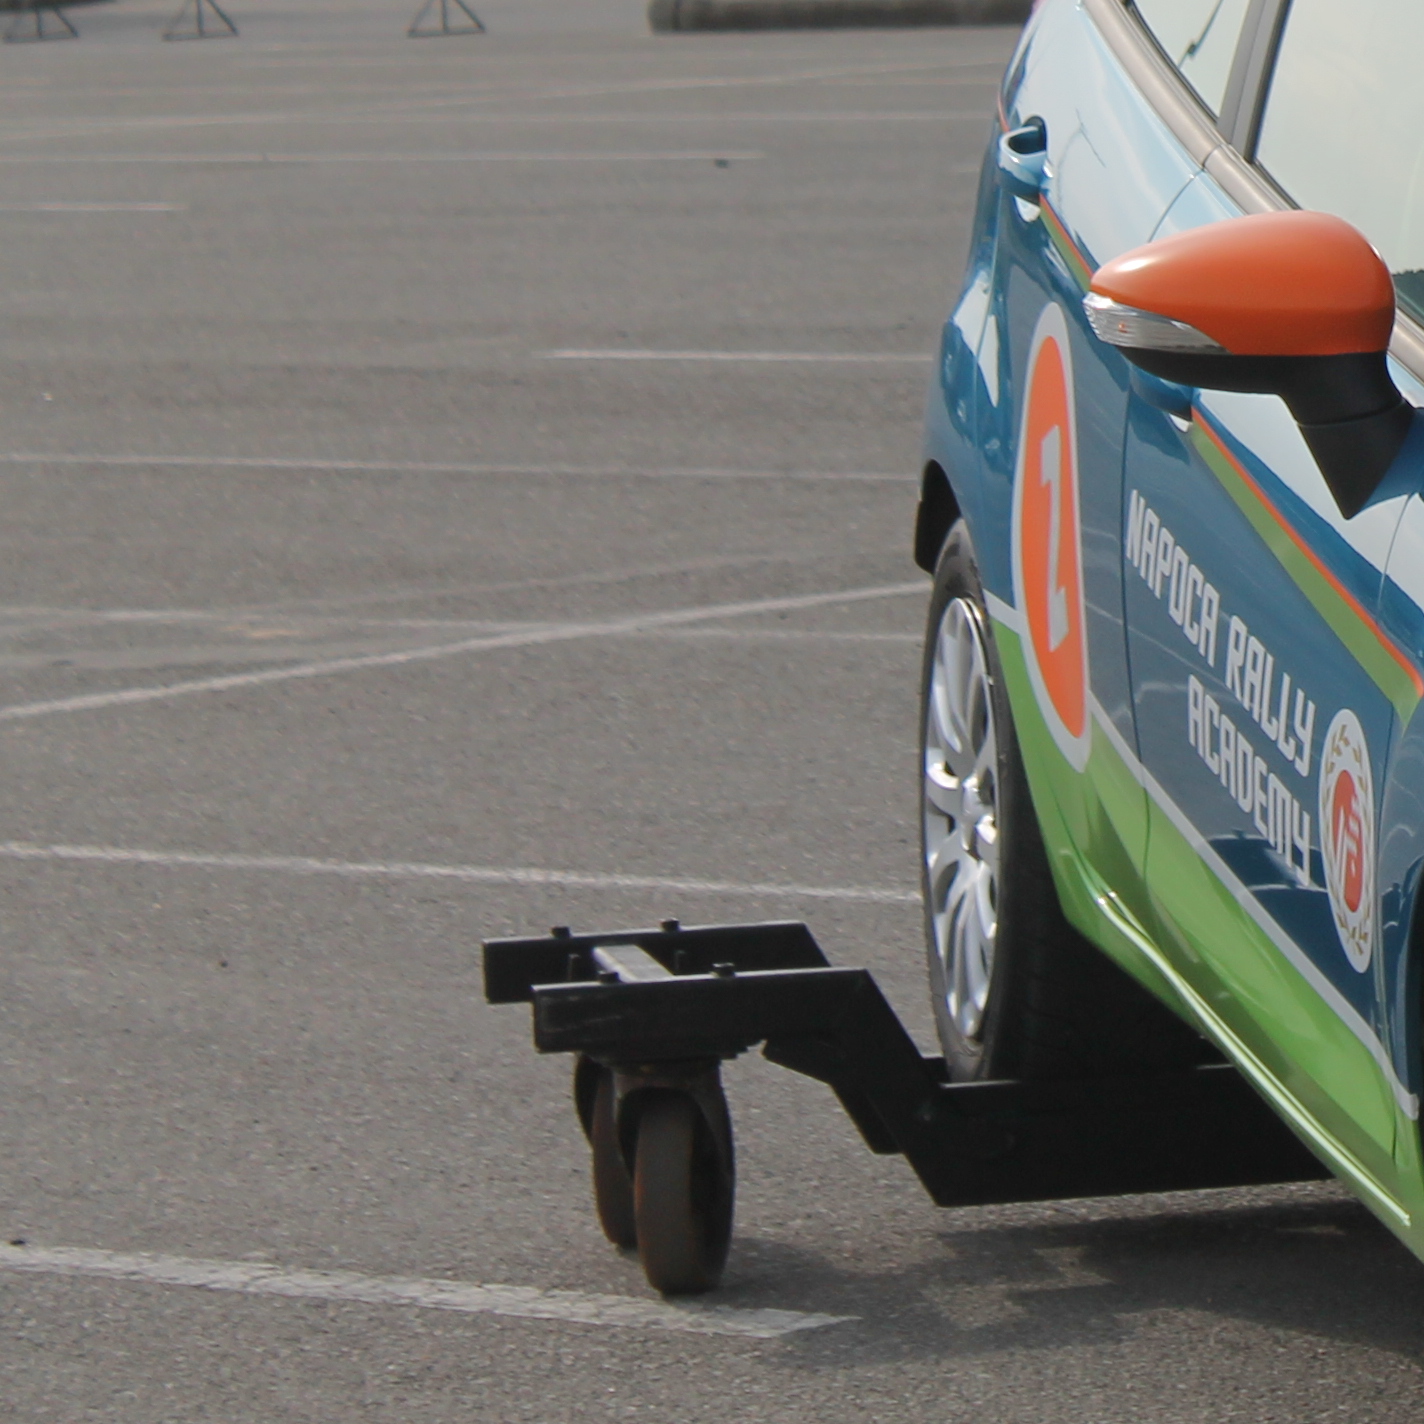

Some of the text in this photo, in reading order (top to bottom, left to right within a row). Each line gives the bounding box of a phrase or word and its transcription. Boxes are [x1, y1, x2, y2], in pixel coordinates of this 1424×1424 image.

[1039, 423, 1069, 654] 2
[1125, 487, 1316, 777] NAPOCA RALLY
[1187, 673, 1312, 887] ACADEMY
